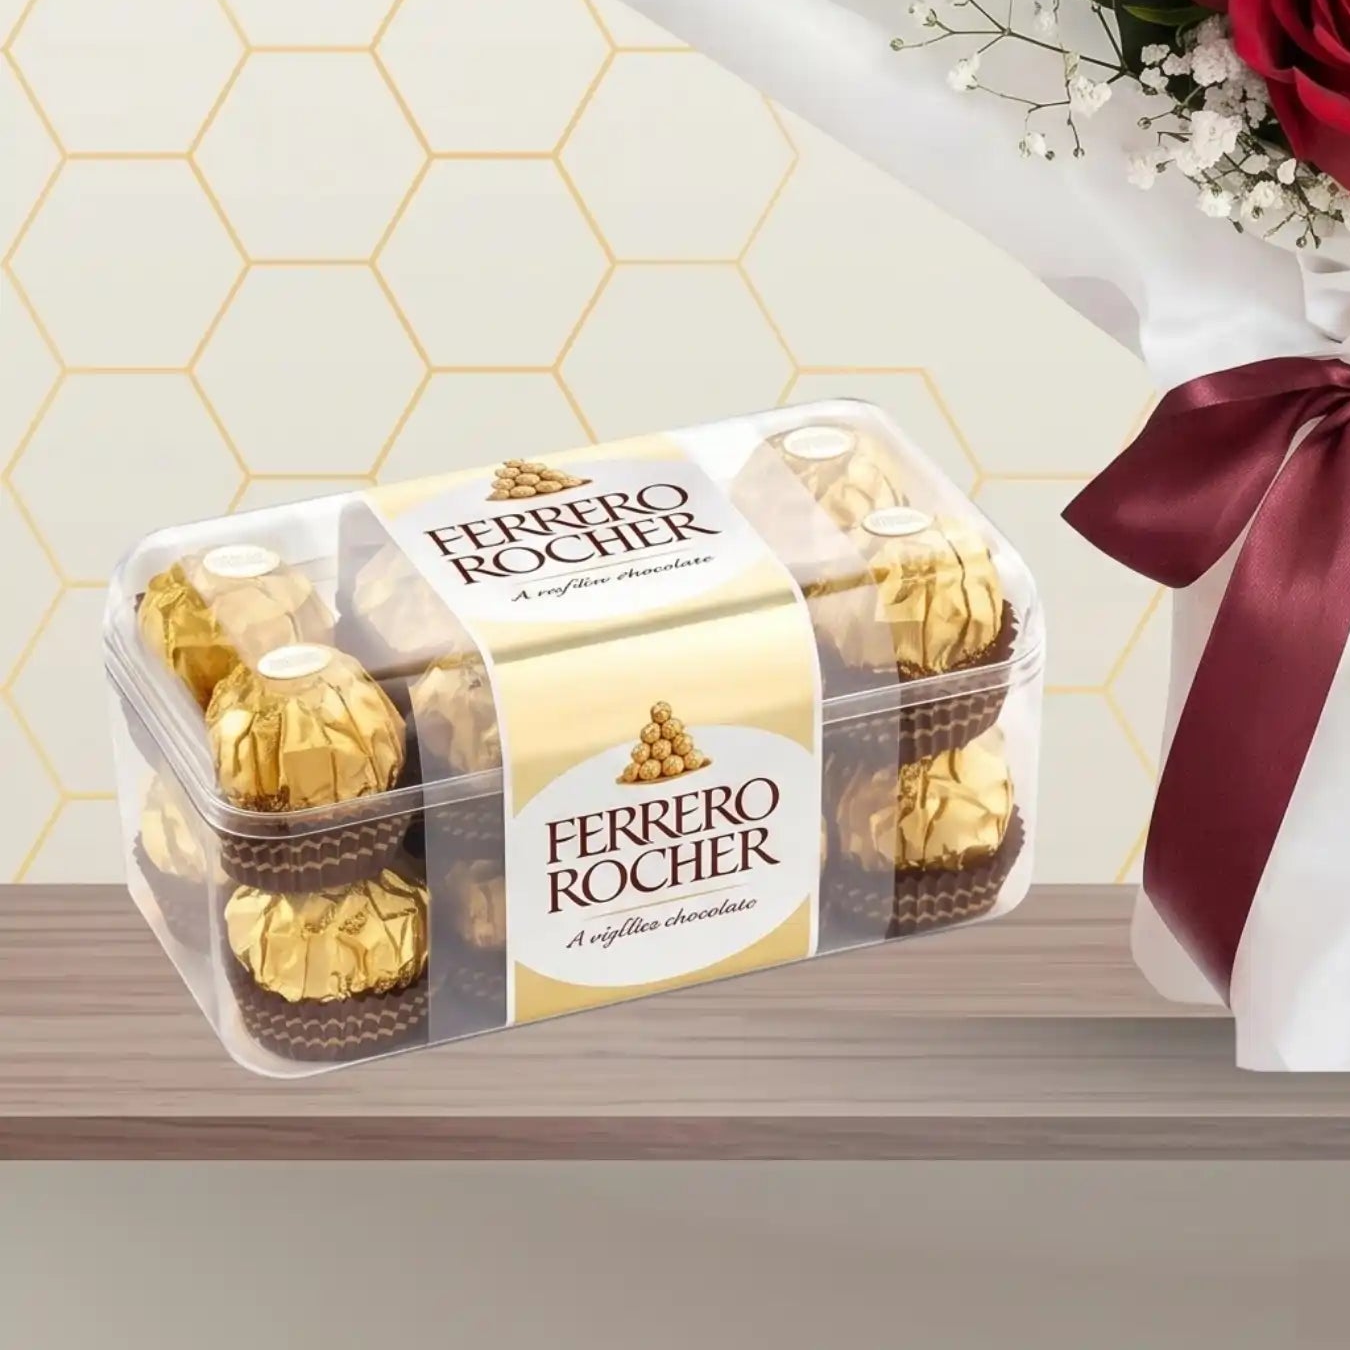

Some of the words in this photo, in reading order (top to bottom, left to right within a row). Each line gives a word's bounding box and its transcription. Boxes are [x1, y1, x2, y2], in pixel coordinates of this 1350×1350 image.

[424, 483, 689, 557] FERRERO
[447, 511, 722, 585] ROCHER
[511, 589, 531, 602] A
[545, 777, 780, 865] FERRERO
[547, 827, 780, 914] ROCHER
[566, 930, 585, 949] A
